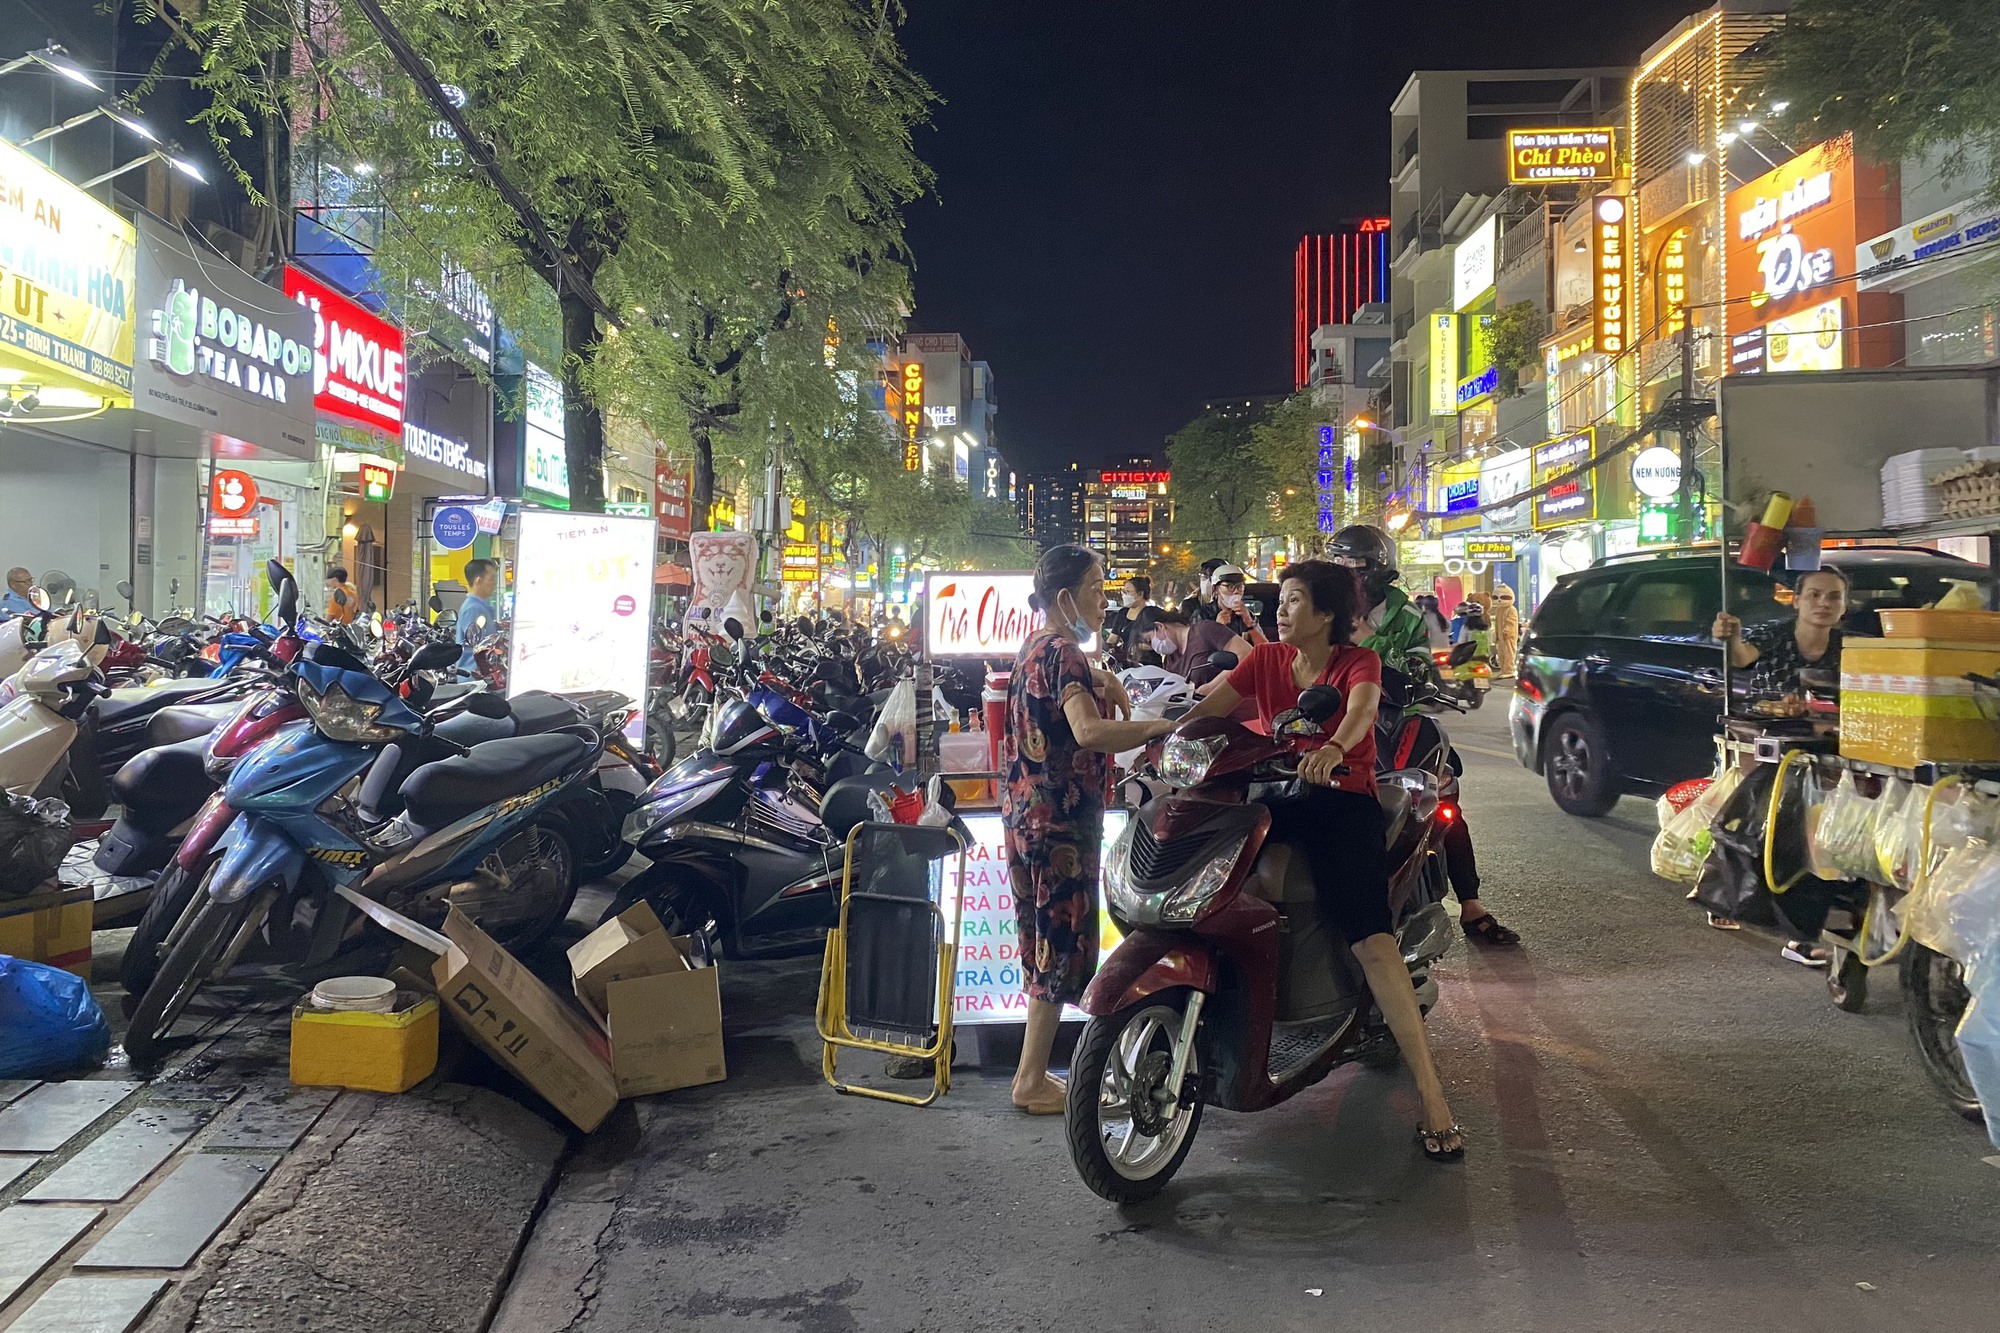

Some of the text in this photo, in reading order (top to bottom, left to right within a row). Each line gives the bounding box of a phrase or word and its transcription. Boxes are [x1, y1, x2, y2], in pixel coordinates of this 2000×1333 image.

[1518, 146, 1606, 165] Chí Phèo
[1602, 224, 1621, 269] NEM
[330, 320, 403, 402] MIXUE
[198, 345, 242, 388] TEA
[244, 364, 287, 404] BAR
[935, 415, 956, 424] UES
[426, 431, 443, 463] LES
[986, 458, 998, 498] YOLA
[1101, 472, 1172, 482] CITIGYM
[1635, 467, 1652, 478] NEM
[1117, 489, 1135, 498] SUSHI
[1487, 543, 1511, 553] Phèo
[936, 583, 968, 644] Trà
[950, 864, 990, 886] TRÀ
[1252, 920, 1277, 934] HONDA
[955, 965, 994, 986] TRÀ
[954, 991, 994, 1012] TRÀ
